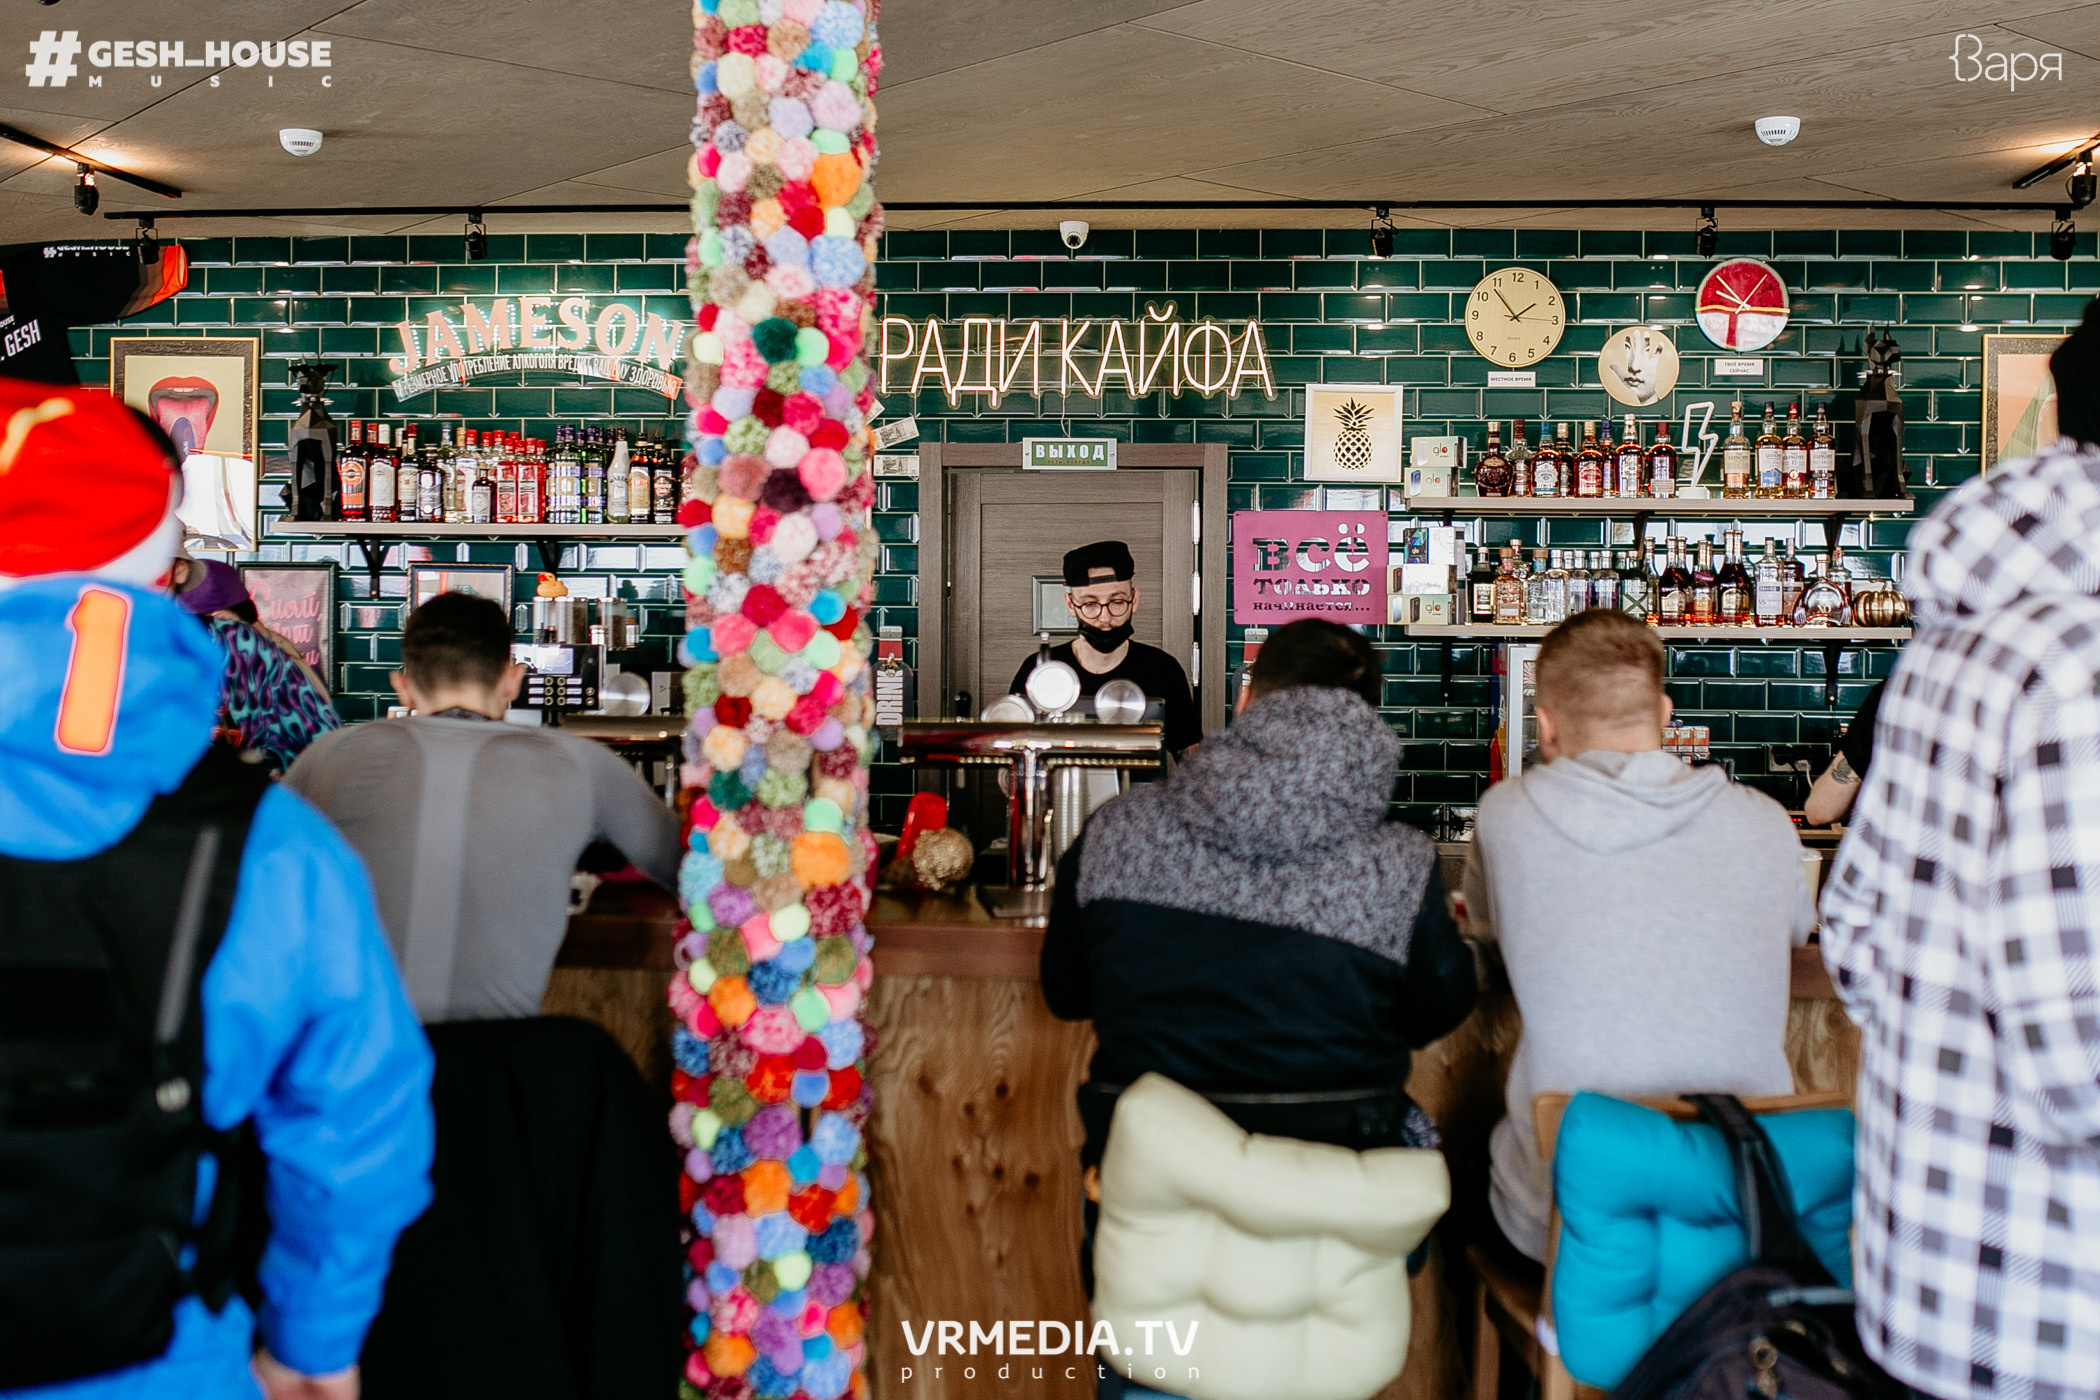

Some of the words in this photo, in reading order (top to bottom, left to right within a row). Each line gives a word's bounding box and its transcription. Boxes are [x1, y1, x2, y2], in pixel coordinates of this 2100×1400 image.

[1493, 277, 1502, 287] 11
[1512, 272, 1524, 283] 12
[1535, 280, 1539, 290] 1
[1476, 291, 1489, 301] 10
[1548, 296, 1556, 306] 2
[1471, 310, 1479, 320] 9
[1551, 316, 1559, 325] 3
[4, 319, 41, 357] GESH
[388, 297, 685, 375] JAMESON
[1476, 331, 1484, 341] 8
[1542, 335, 1550, 345] 4
[1490, 345, 1497, 355] 7
[1527, 348, 1535, 358] 5
[880, 318, 1039, 407] РАДИ
[1060, 304, 1273, 398] КАЙФА
[1509, 352, 1516, 362] 6
[512, 352, 556, 370] АЛКОГОЛЯ
[1035, 444, 1104, 460] ВЫХОД
[876, 670, 903, 725] DRINK
